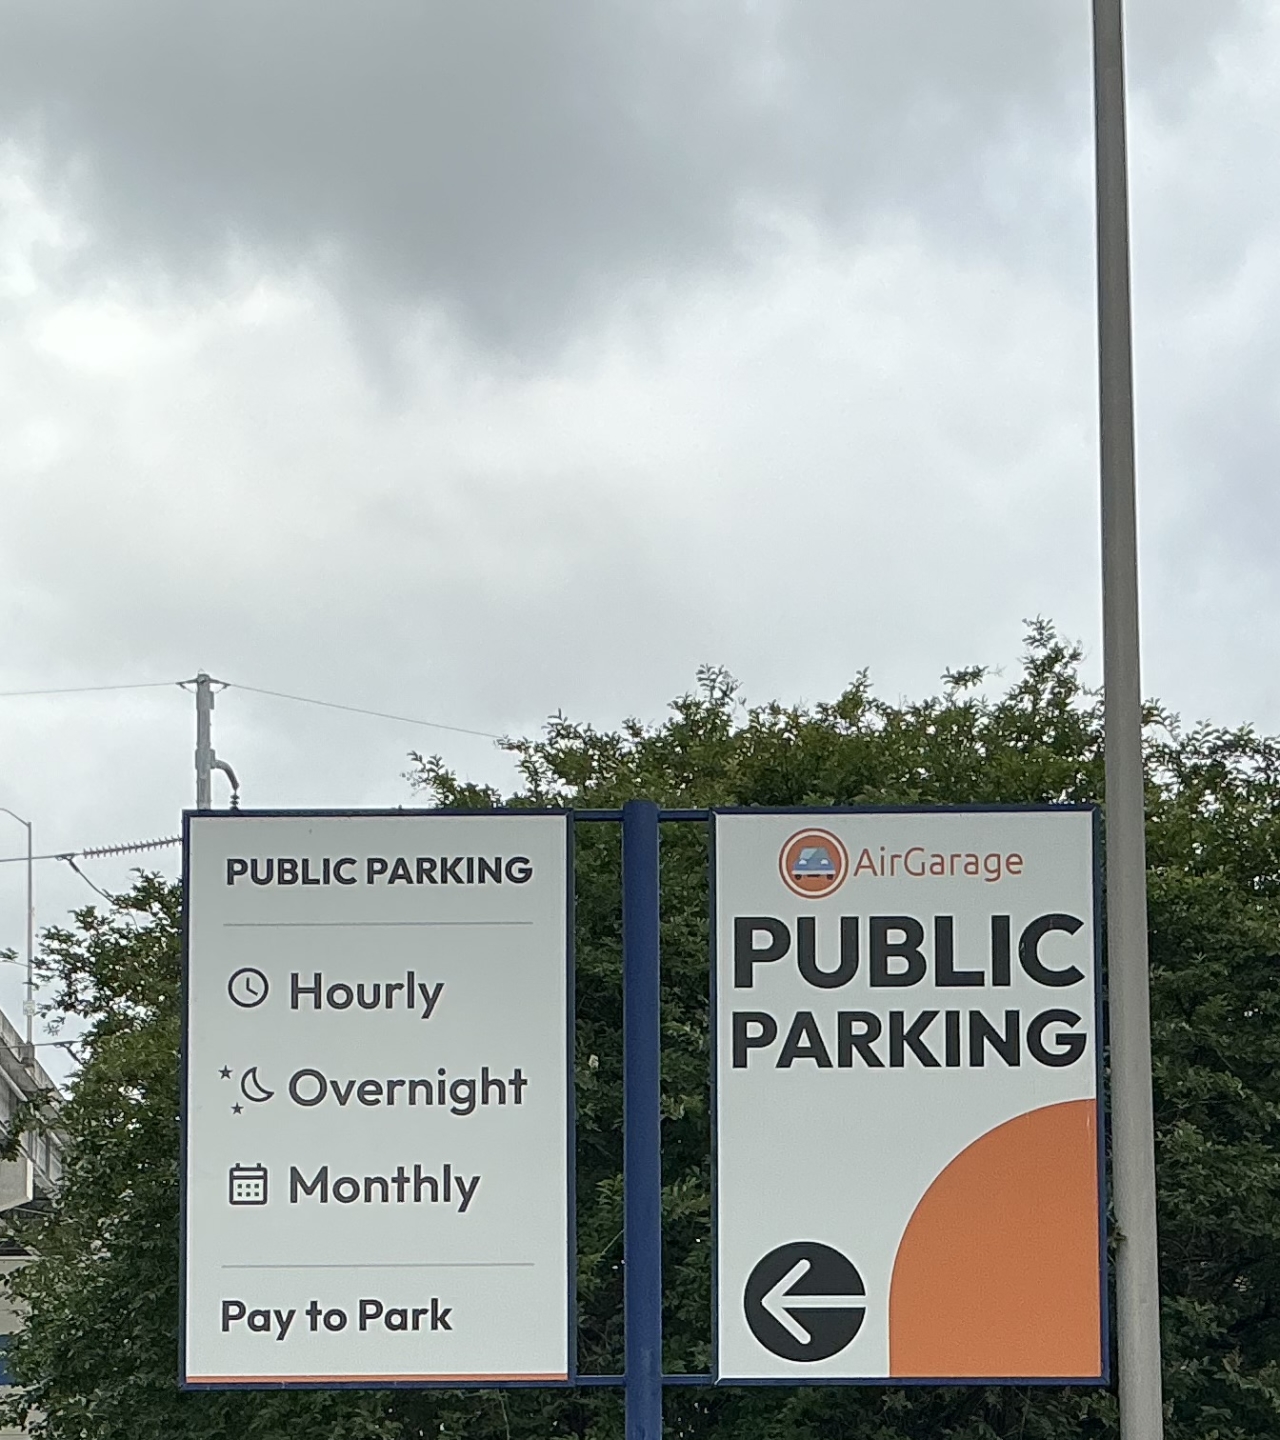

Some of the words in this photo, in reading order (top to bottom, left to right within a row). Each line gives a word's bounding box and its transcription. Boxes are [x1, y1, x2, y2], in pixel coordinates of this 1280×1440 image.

[226, 857, 358, 886] PUBLIC
[366, 856, 533, 885] PARKING
[853, 846, 1024, 883] AirGarage
[733, 912, 1086, 990] PUBLIC
[290, 970, 445, 1020] Hourly
[732, 1008, 1088, 1069] PARKING
[288, 1066, 528, 1116] Overnight
[290, 1163, 481, 1213] Monthly
[221, 1300, 297, 1342] Pay
[305, 1300, 348, 1332] to
[359, 1297, 453, 1332] Park
